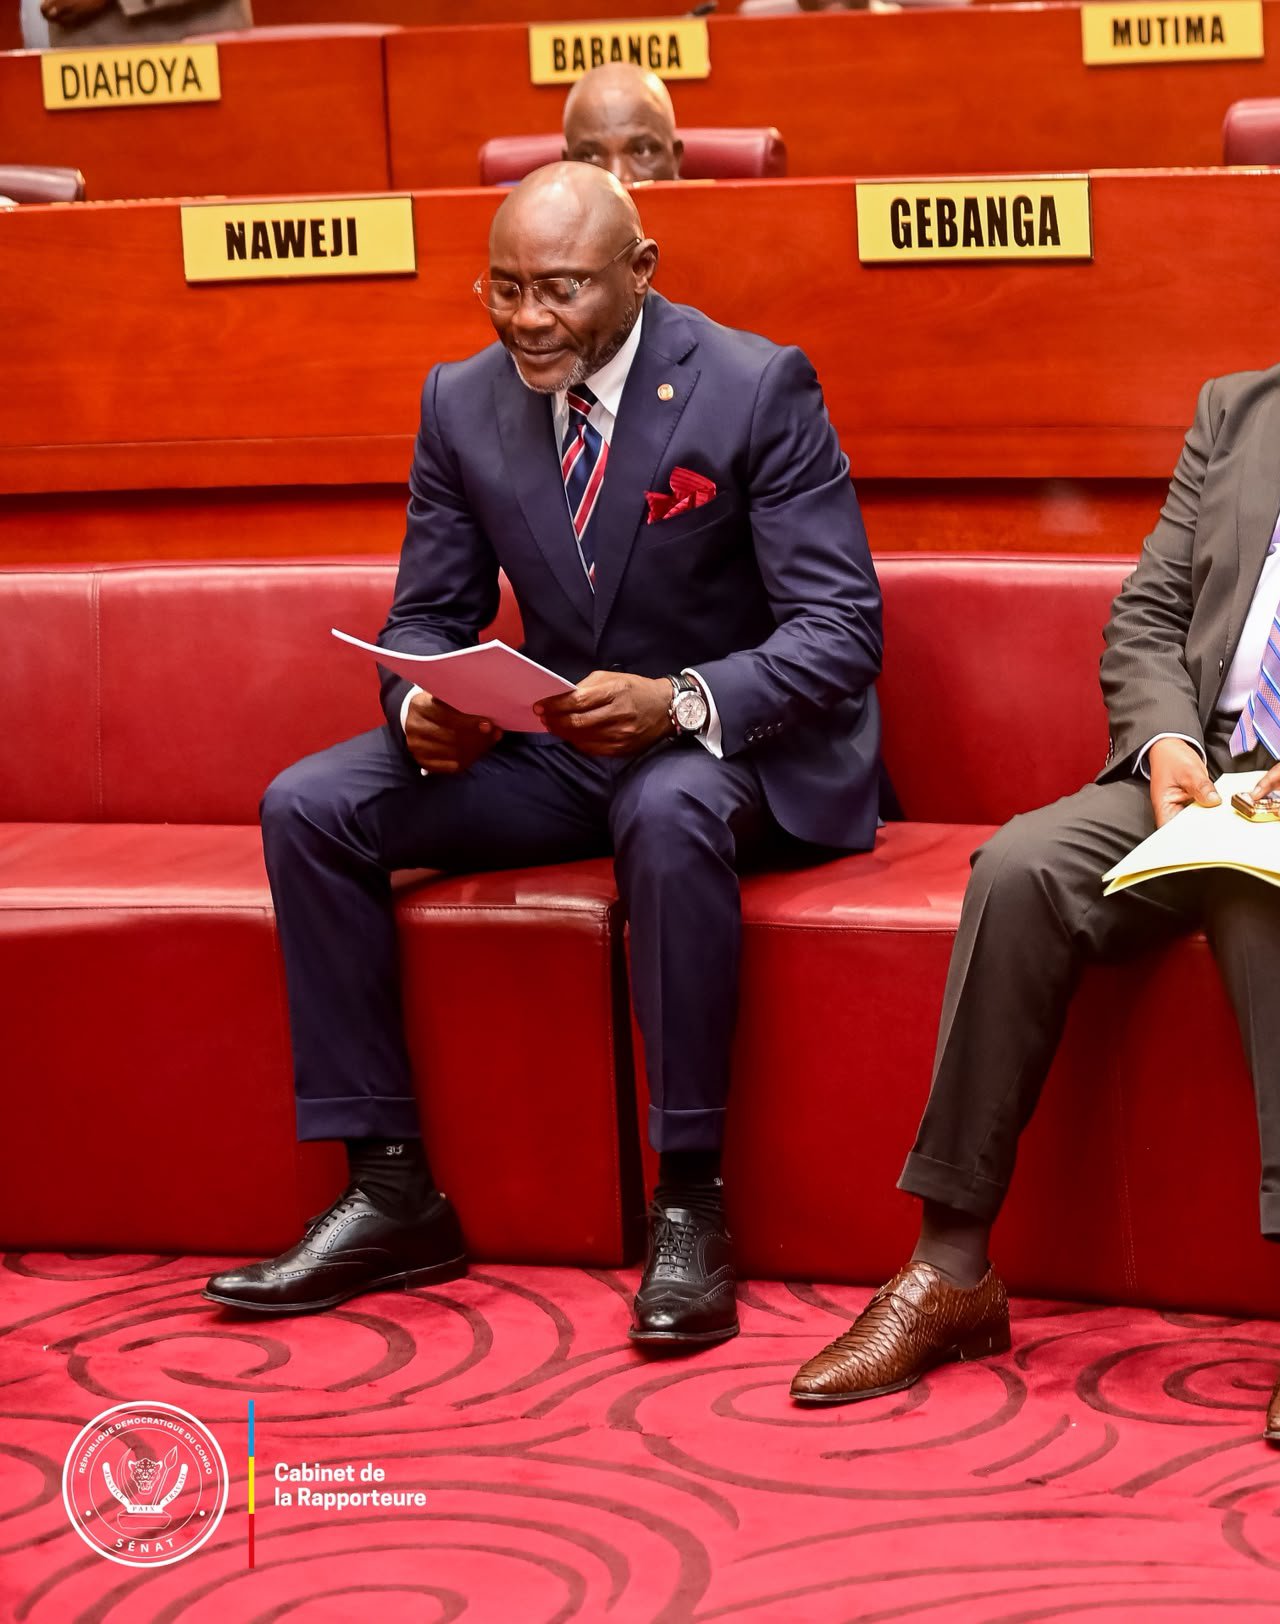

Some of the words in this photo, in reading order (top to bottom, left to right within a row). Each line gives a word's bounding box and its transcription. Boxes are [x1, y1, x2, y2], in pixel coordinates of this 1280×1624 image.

[1113, 15, 1224, 46] MUTIMA
[61, 57, 202, 100] DIAHOYA
[225, 217, 358, 260] NAWEJI
[890, 195, 1061, 249] GEBANGA
